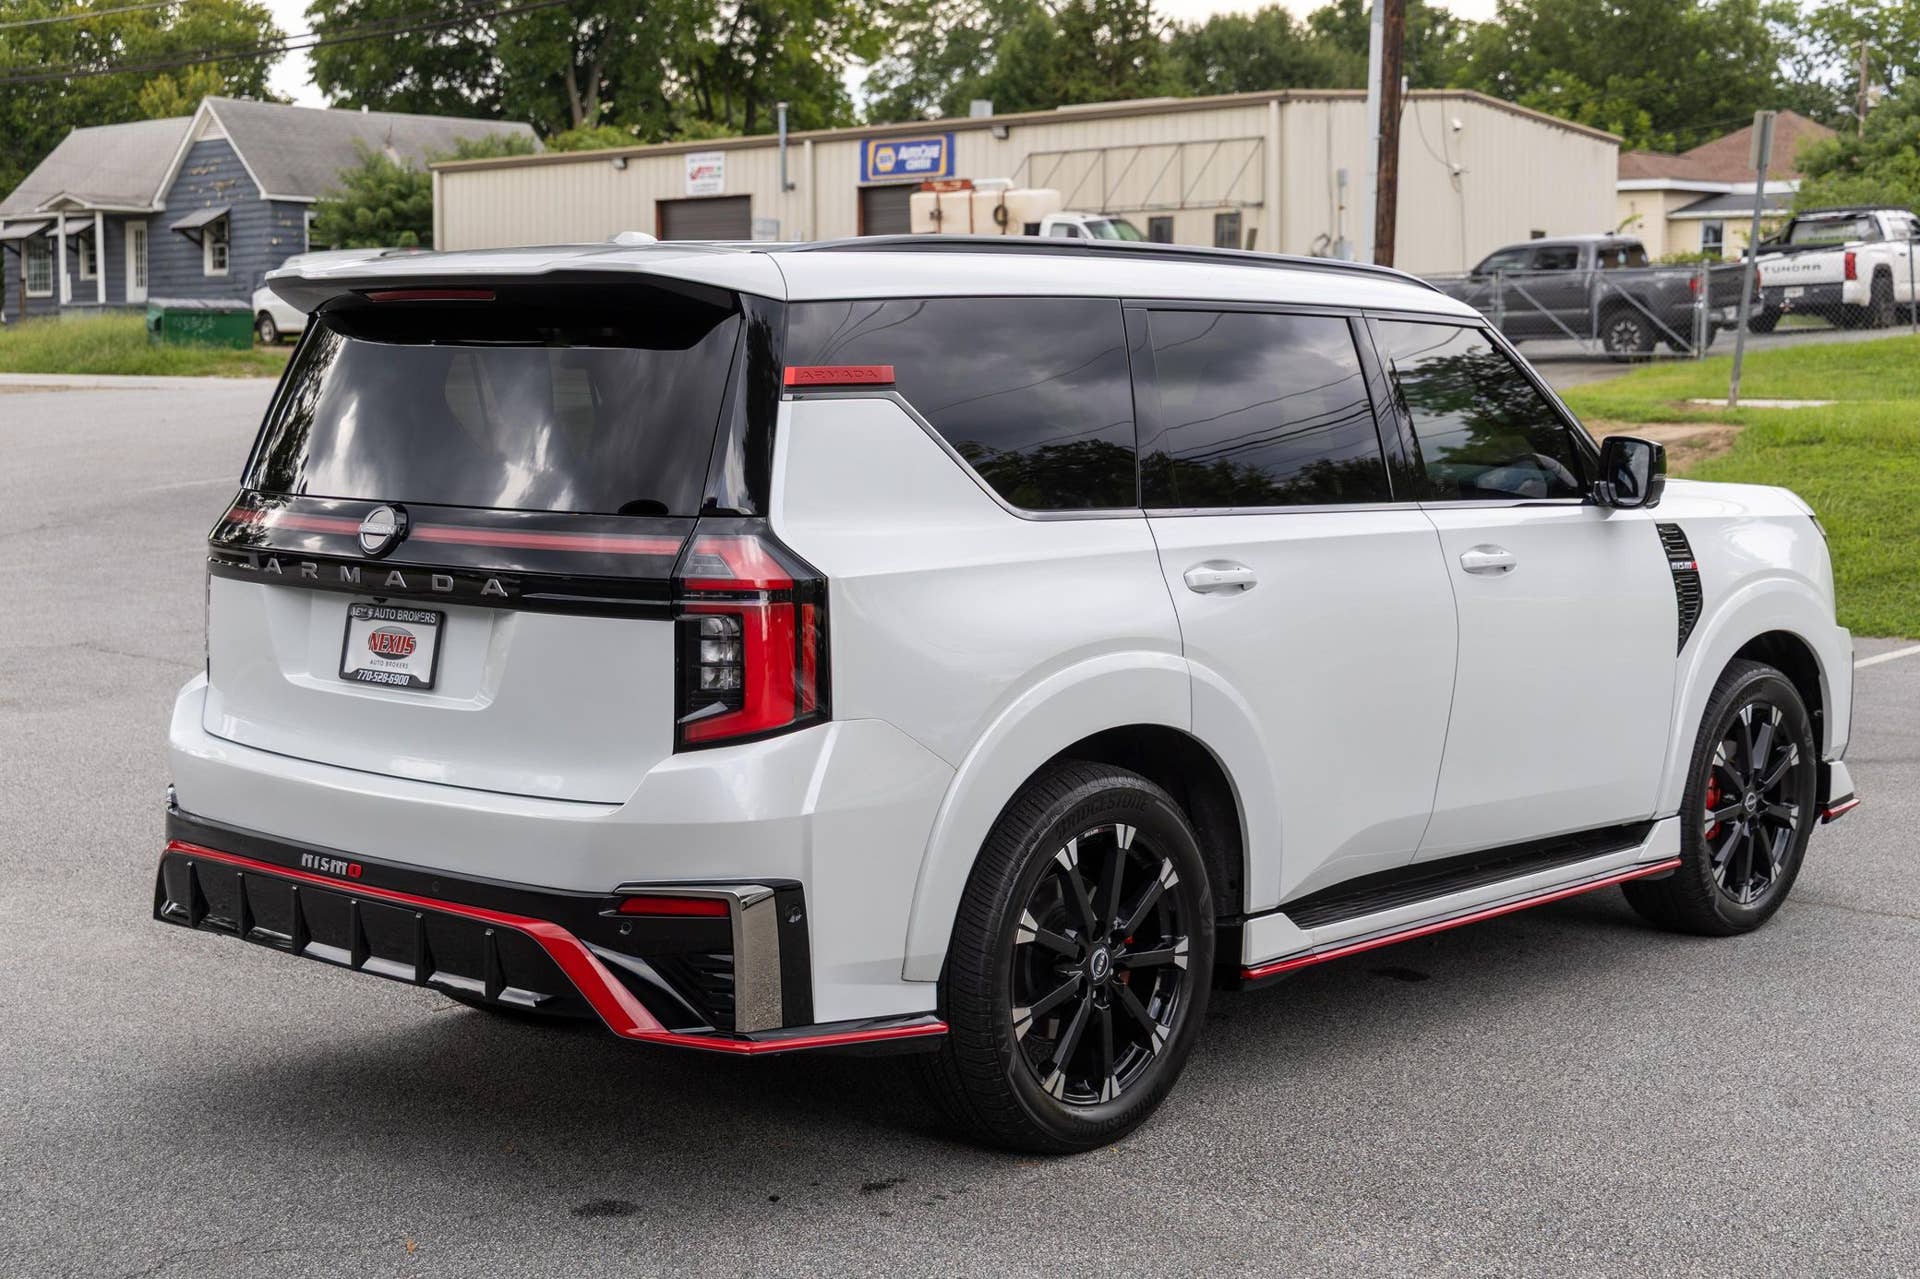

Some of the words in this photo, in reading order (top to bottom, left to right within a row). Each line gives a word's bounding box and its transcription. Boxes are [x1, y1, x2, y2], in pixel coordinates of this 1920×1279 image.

[1763, 263, 1822, 274] TUNDRA
[263, 557, 509, 598] ARMADA
[374, 608, 396, 620] AUTO
[397, 610, 437, 624] BROKERS
[368, 632, 416, 656] NEXUS
[370, 659, 384, 667] AUTO
[385, 661, 409, 670] BROKERS
[357, 669, 410, 686] 770-528-6900
